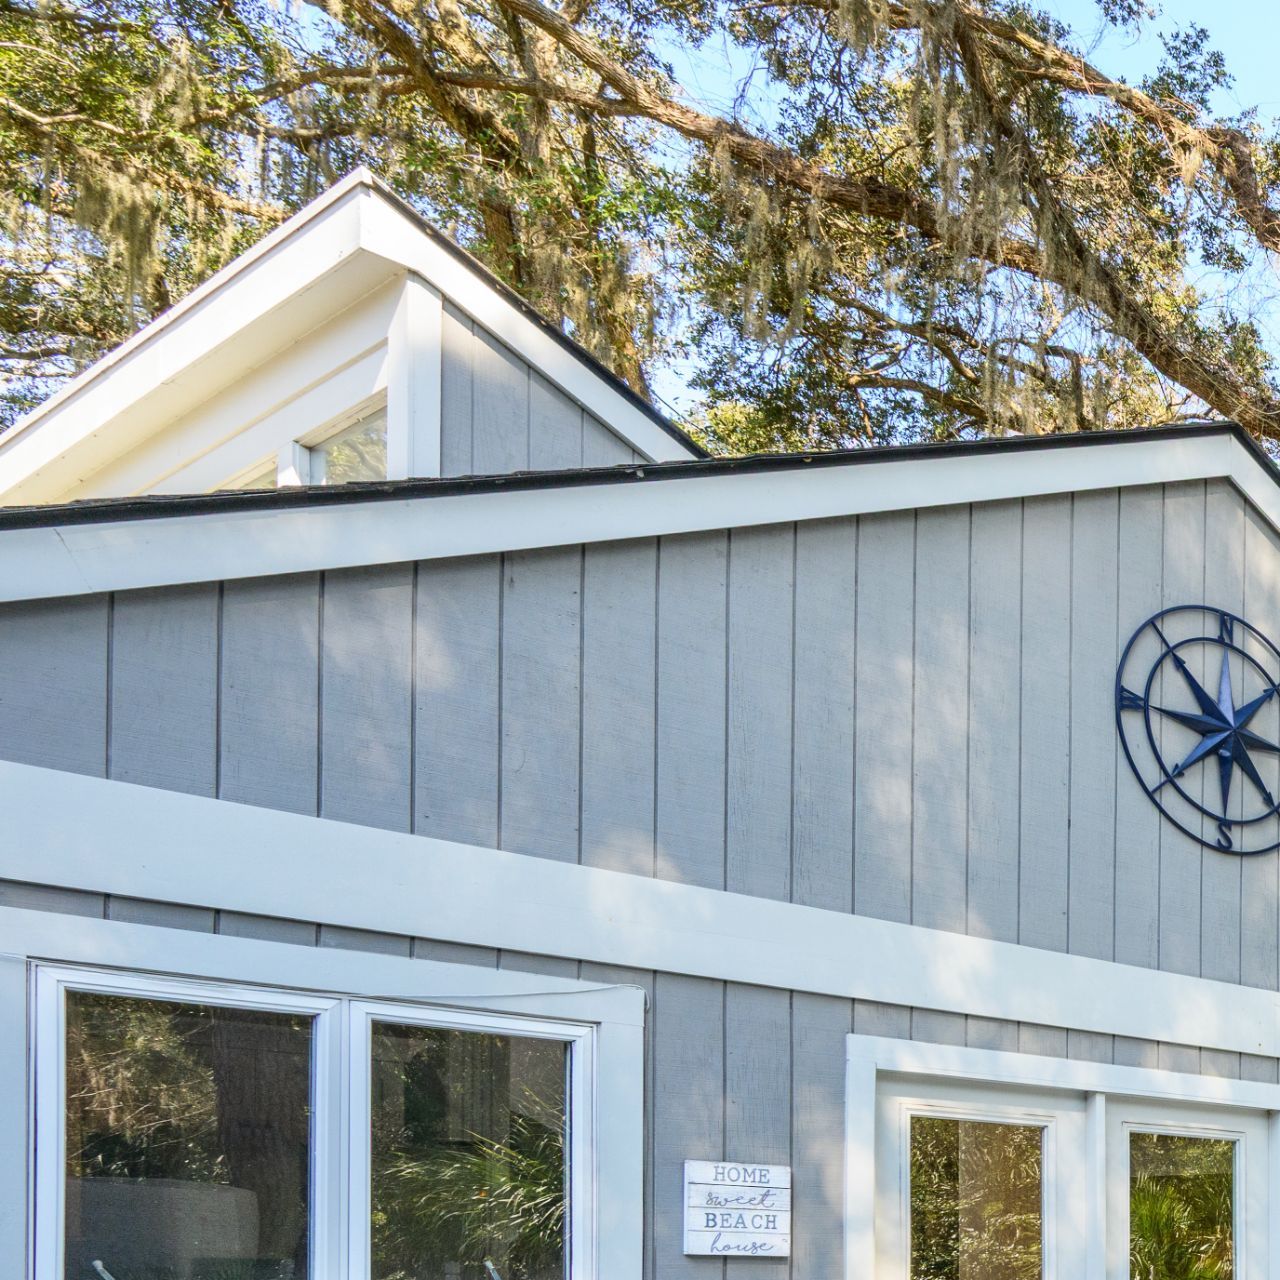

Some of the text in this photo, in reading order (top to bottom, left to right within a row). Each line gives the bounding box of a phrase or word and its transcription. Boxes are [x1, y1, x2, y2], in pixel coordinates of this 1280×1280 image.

[1218, 612, 1234, 645] N
[1217, 820, 1233, 850] S
[713, 1165, 770, 1184] HOME
[706, 1189, 776, 1208] sweet
[704, 1212, 777, 1230] BEACH
[710, 1232, 774, 1254] house
